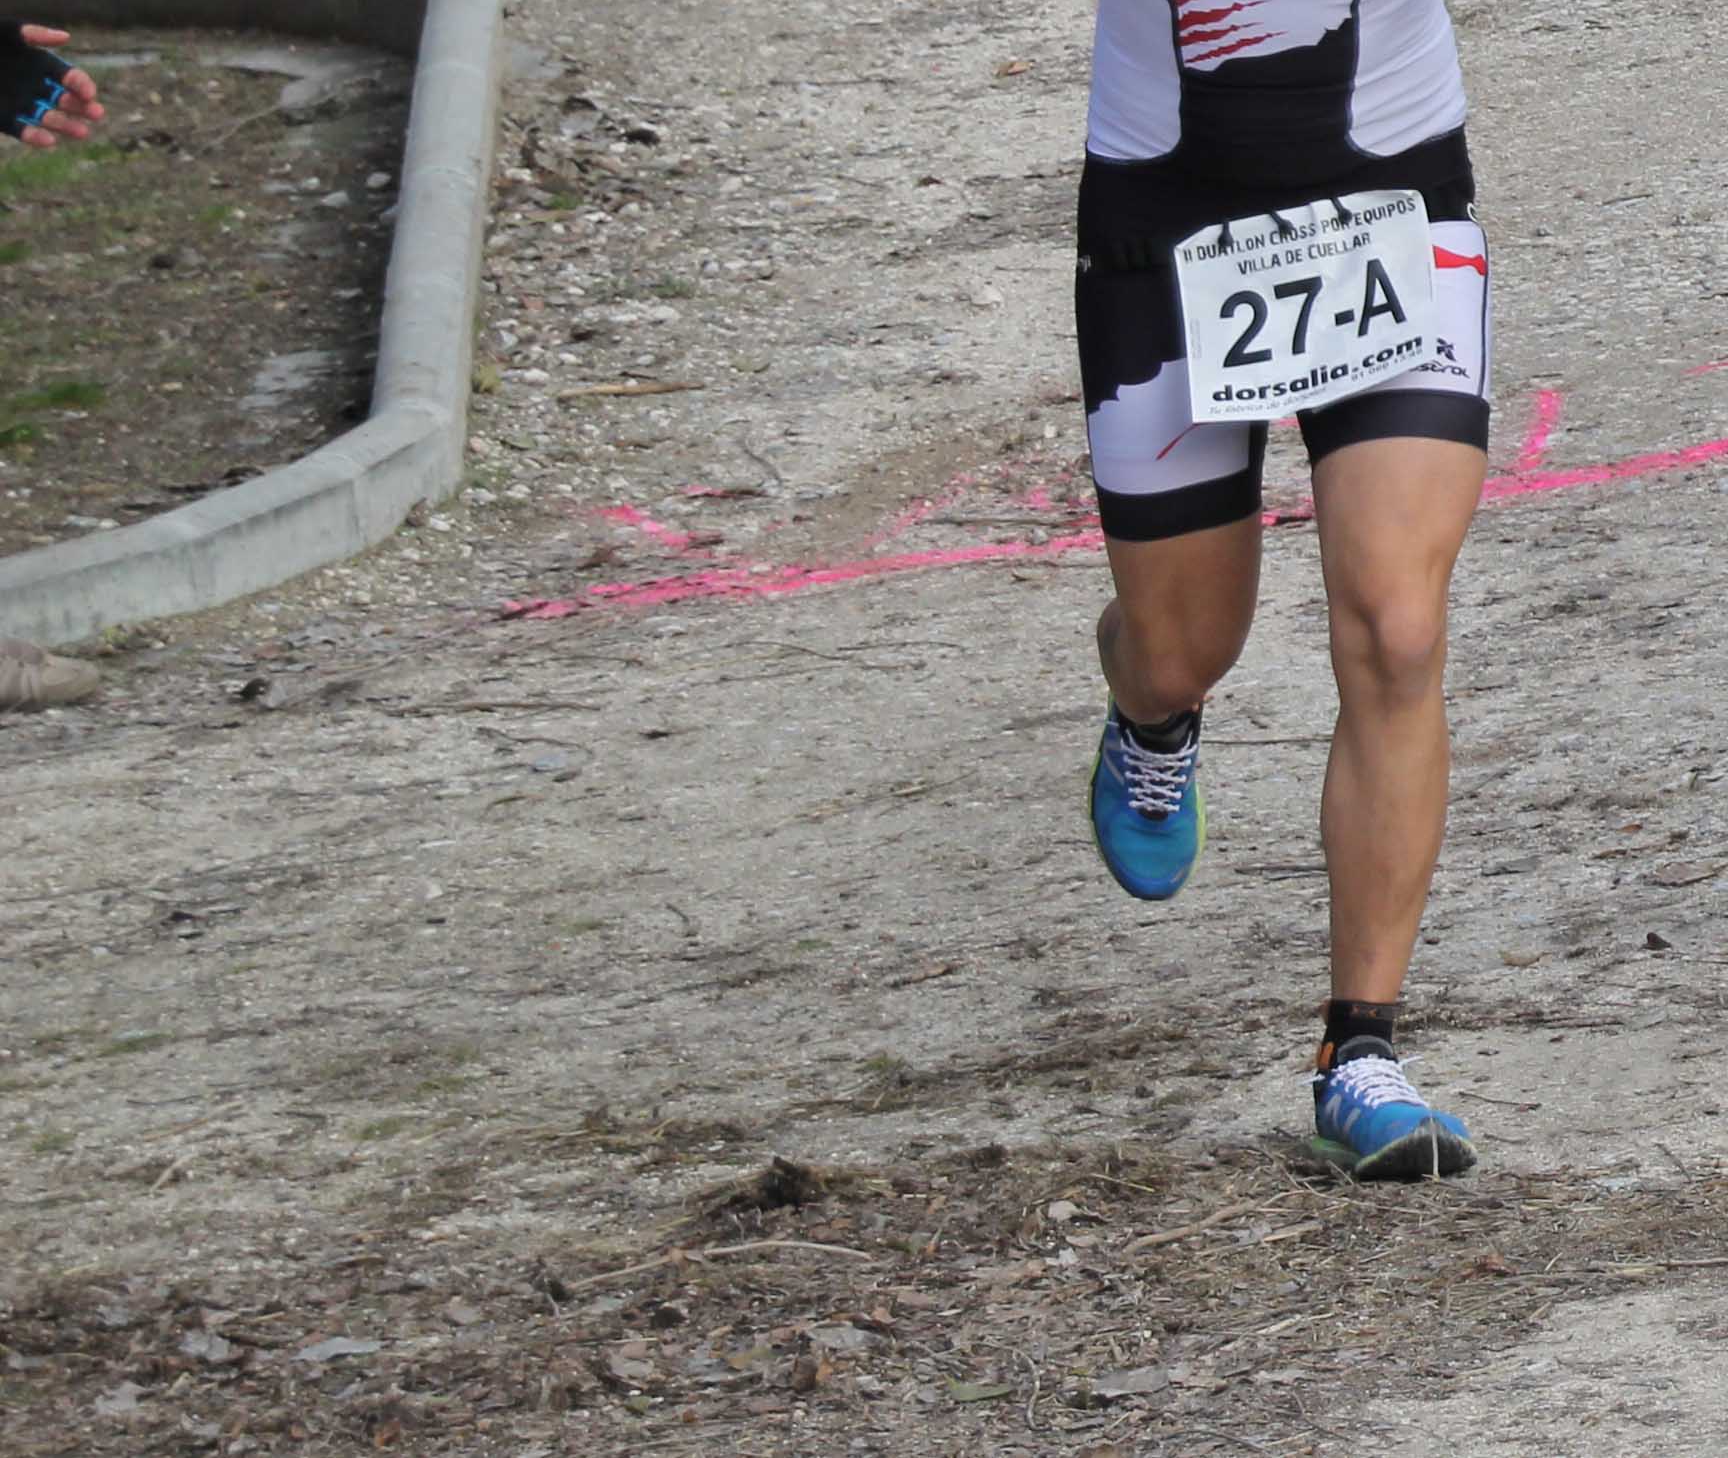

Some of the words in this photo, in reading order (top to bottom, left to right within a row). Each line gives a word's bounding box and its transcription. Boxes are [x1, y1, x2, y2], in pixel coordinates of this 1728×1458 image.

[1183, 249, 1194, 263] II
[1353, 197, 1417, 226] EQUIPOS
[1238, 256, 1282, 276] VILLA
[1285, 249, 1303, 266] DE
[1308, 232, 1371, 261] CUELLAR
[1219, 258, 1408, 368] 27-A
[1212, 337, 1423, 403] dorsalia.com
